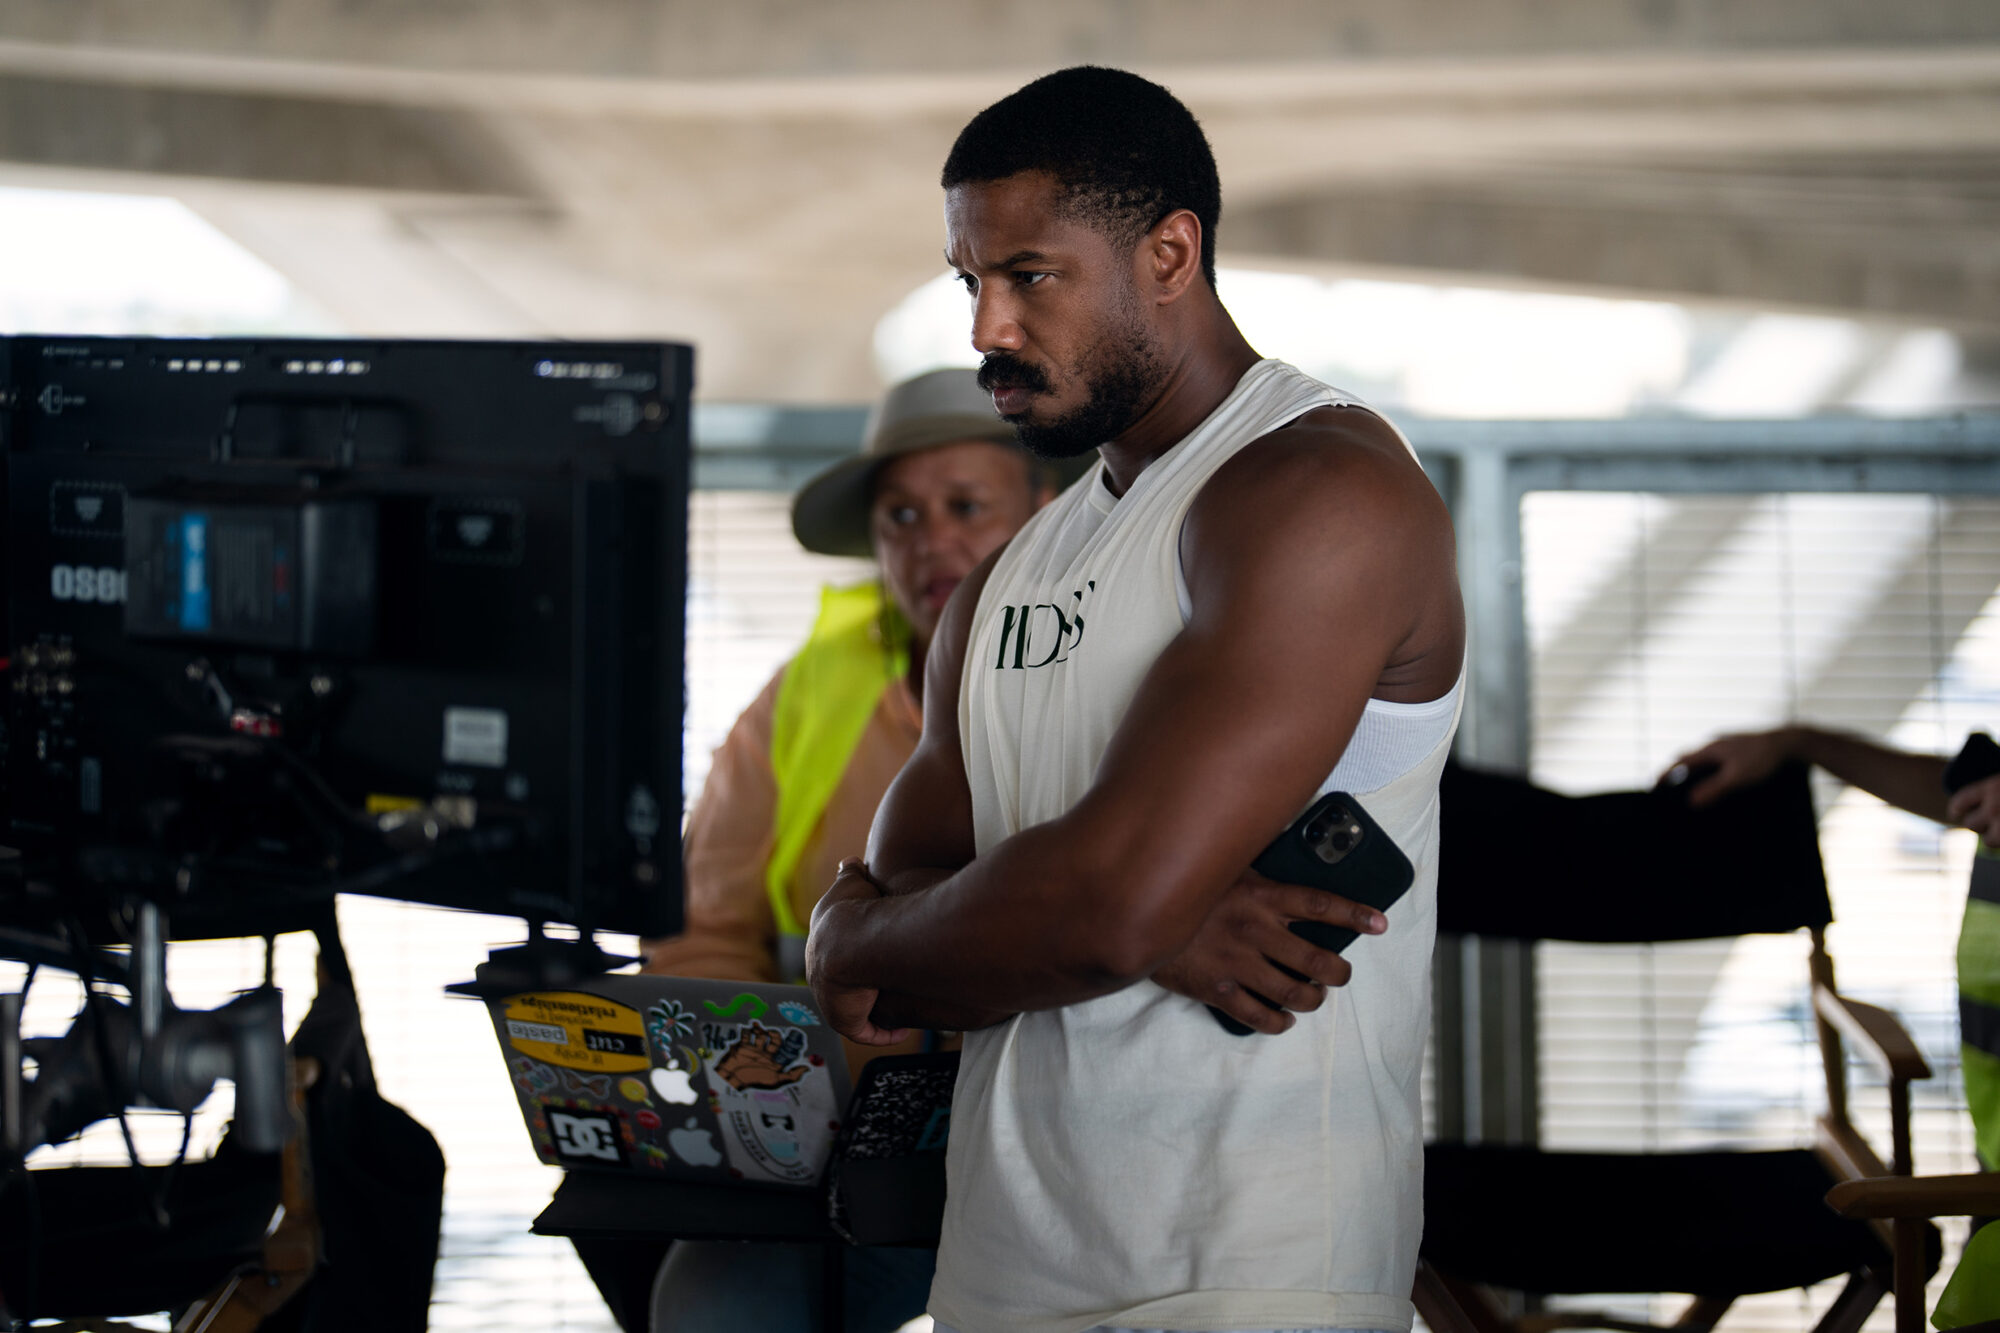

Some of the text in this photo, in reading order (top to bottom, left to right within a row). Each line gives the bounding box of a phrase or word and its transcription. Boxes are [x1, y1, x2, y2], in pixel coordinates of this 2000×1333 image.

[520, 996, 617, 1019] relationships
[511, 1023, 566, 1042] paste
[588, 1035, 626, 1051] cut
